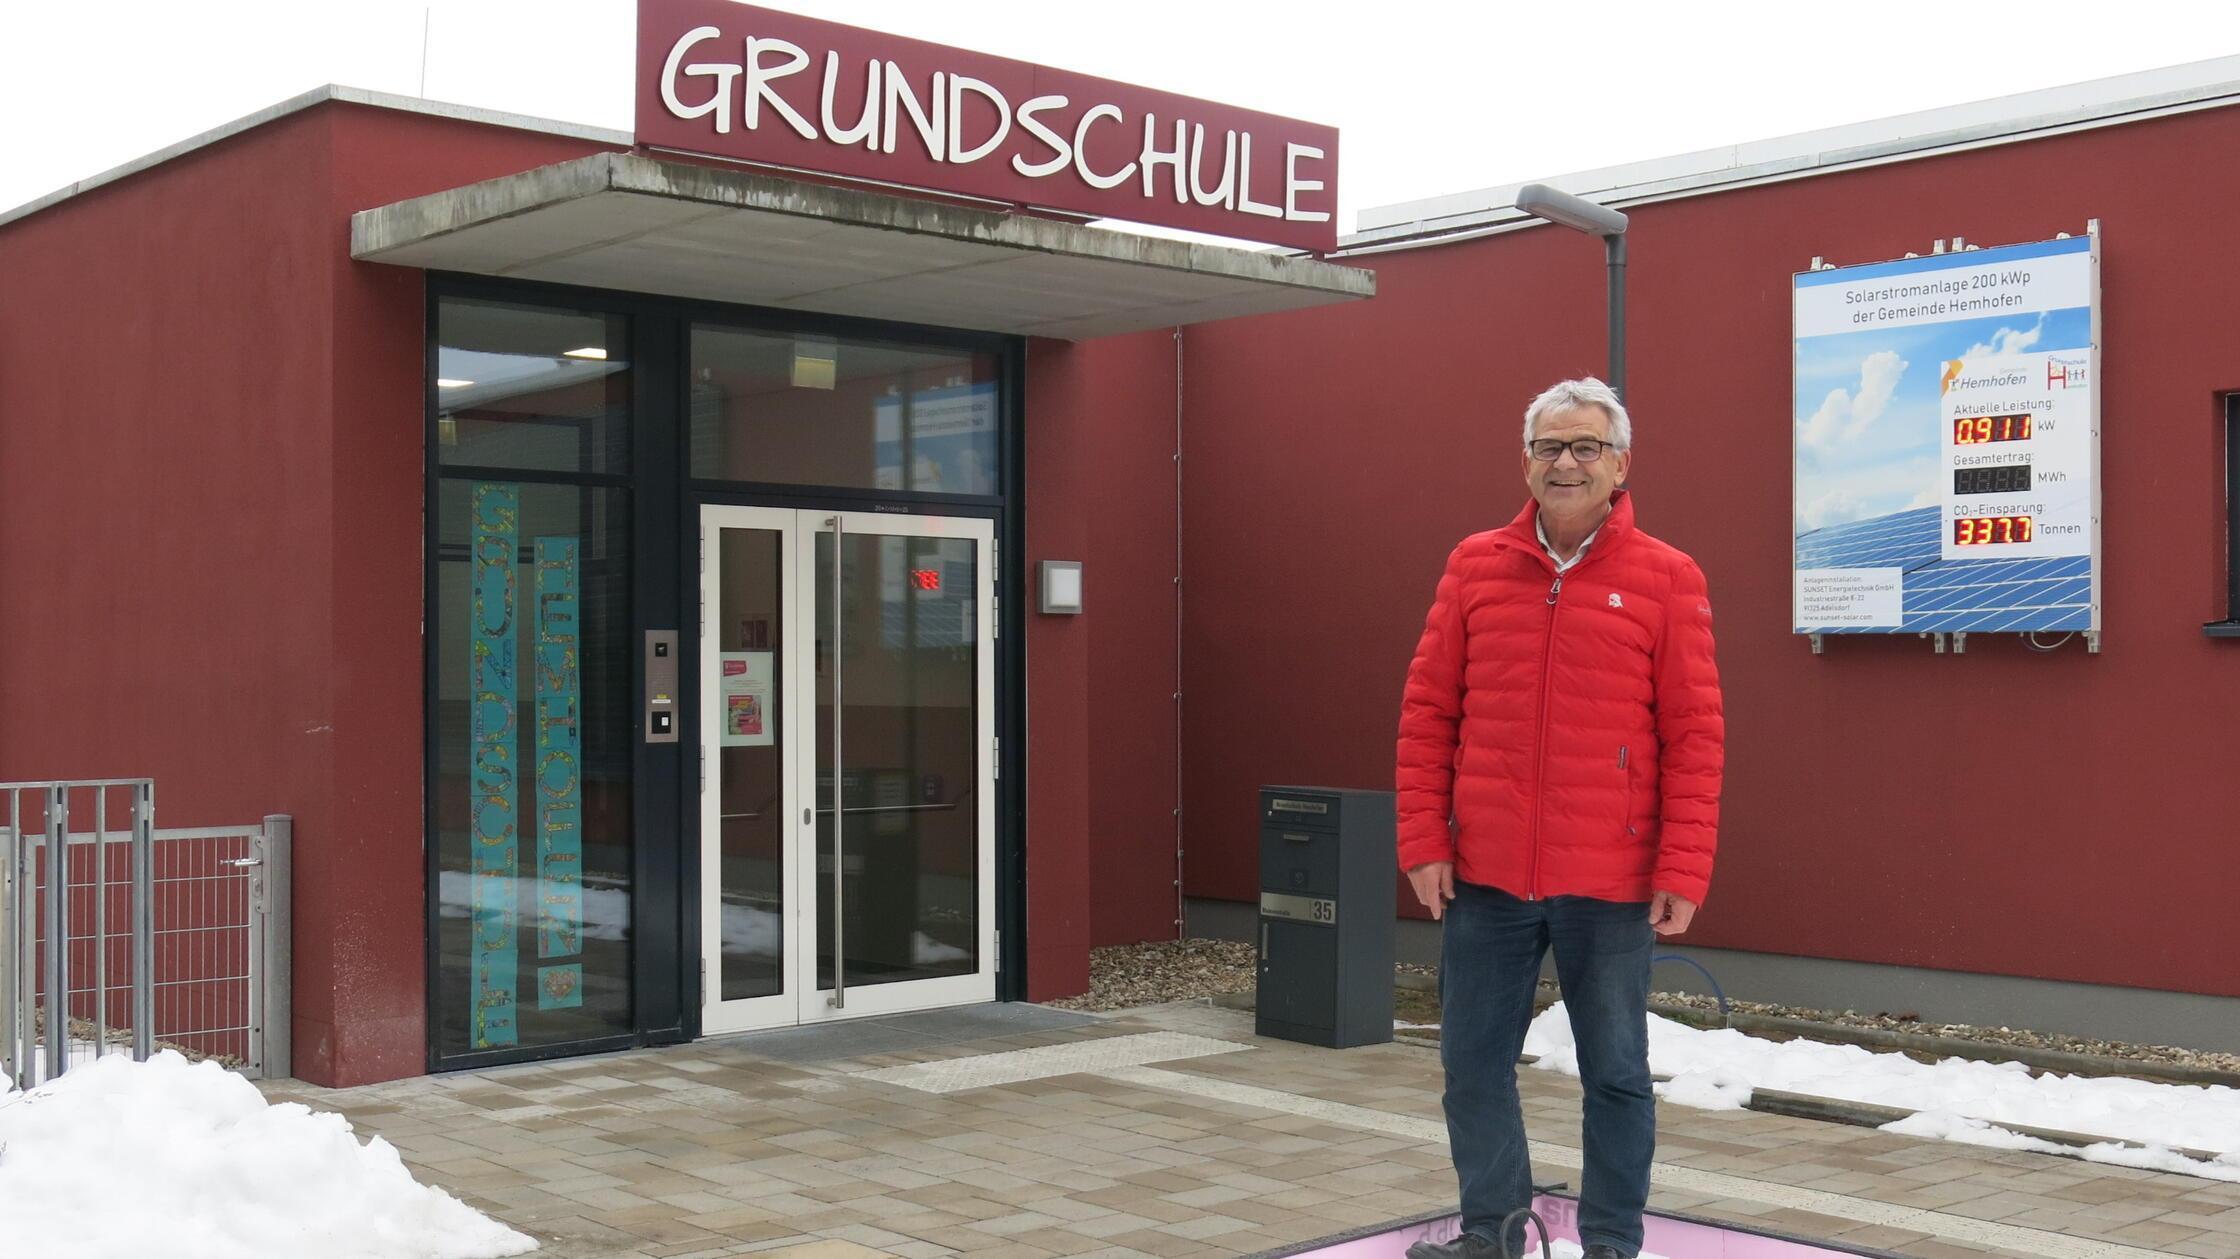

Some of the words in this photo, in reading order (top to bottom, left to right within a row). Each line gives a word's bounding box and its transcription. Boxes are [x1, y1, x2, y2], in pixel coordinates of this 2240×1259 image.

[660, 26, 1330, 222] GRUNDSCHULE
[1845, 280, 1969, 304] Solarstromanlage
[1972, 273, 1997, 289] 200
[2001, 270, 2031, 286] kWp
[1853, 310, 1875, 324] der
[1878, 303, 1945, 320] Gemeinde
[1949, 293, 2023, 312] Hemhofen
[1960, 373, 2027, 390] Hemhofen
[1954, 402, 2000, 415] Aktuelle
[2038, 420, 2055, 431] kW
[1953, 452, 2035, 466] Gesamtertrag:
[2038, 472, 2066, 482] MWh
[2039, 524, 2081, 535] Tonnen
[1314, 901, 1332, 920] 35
